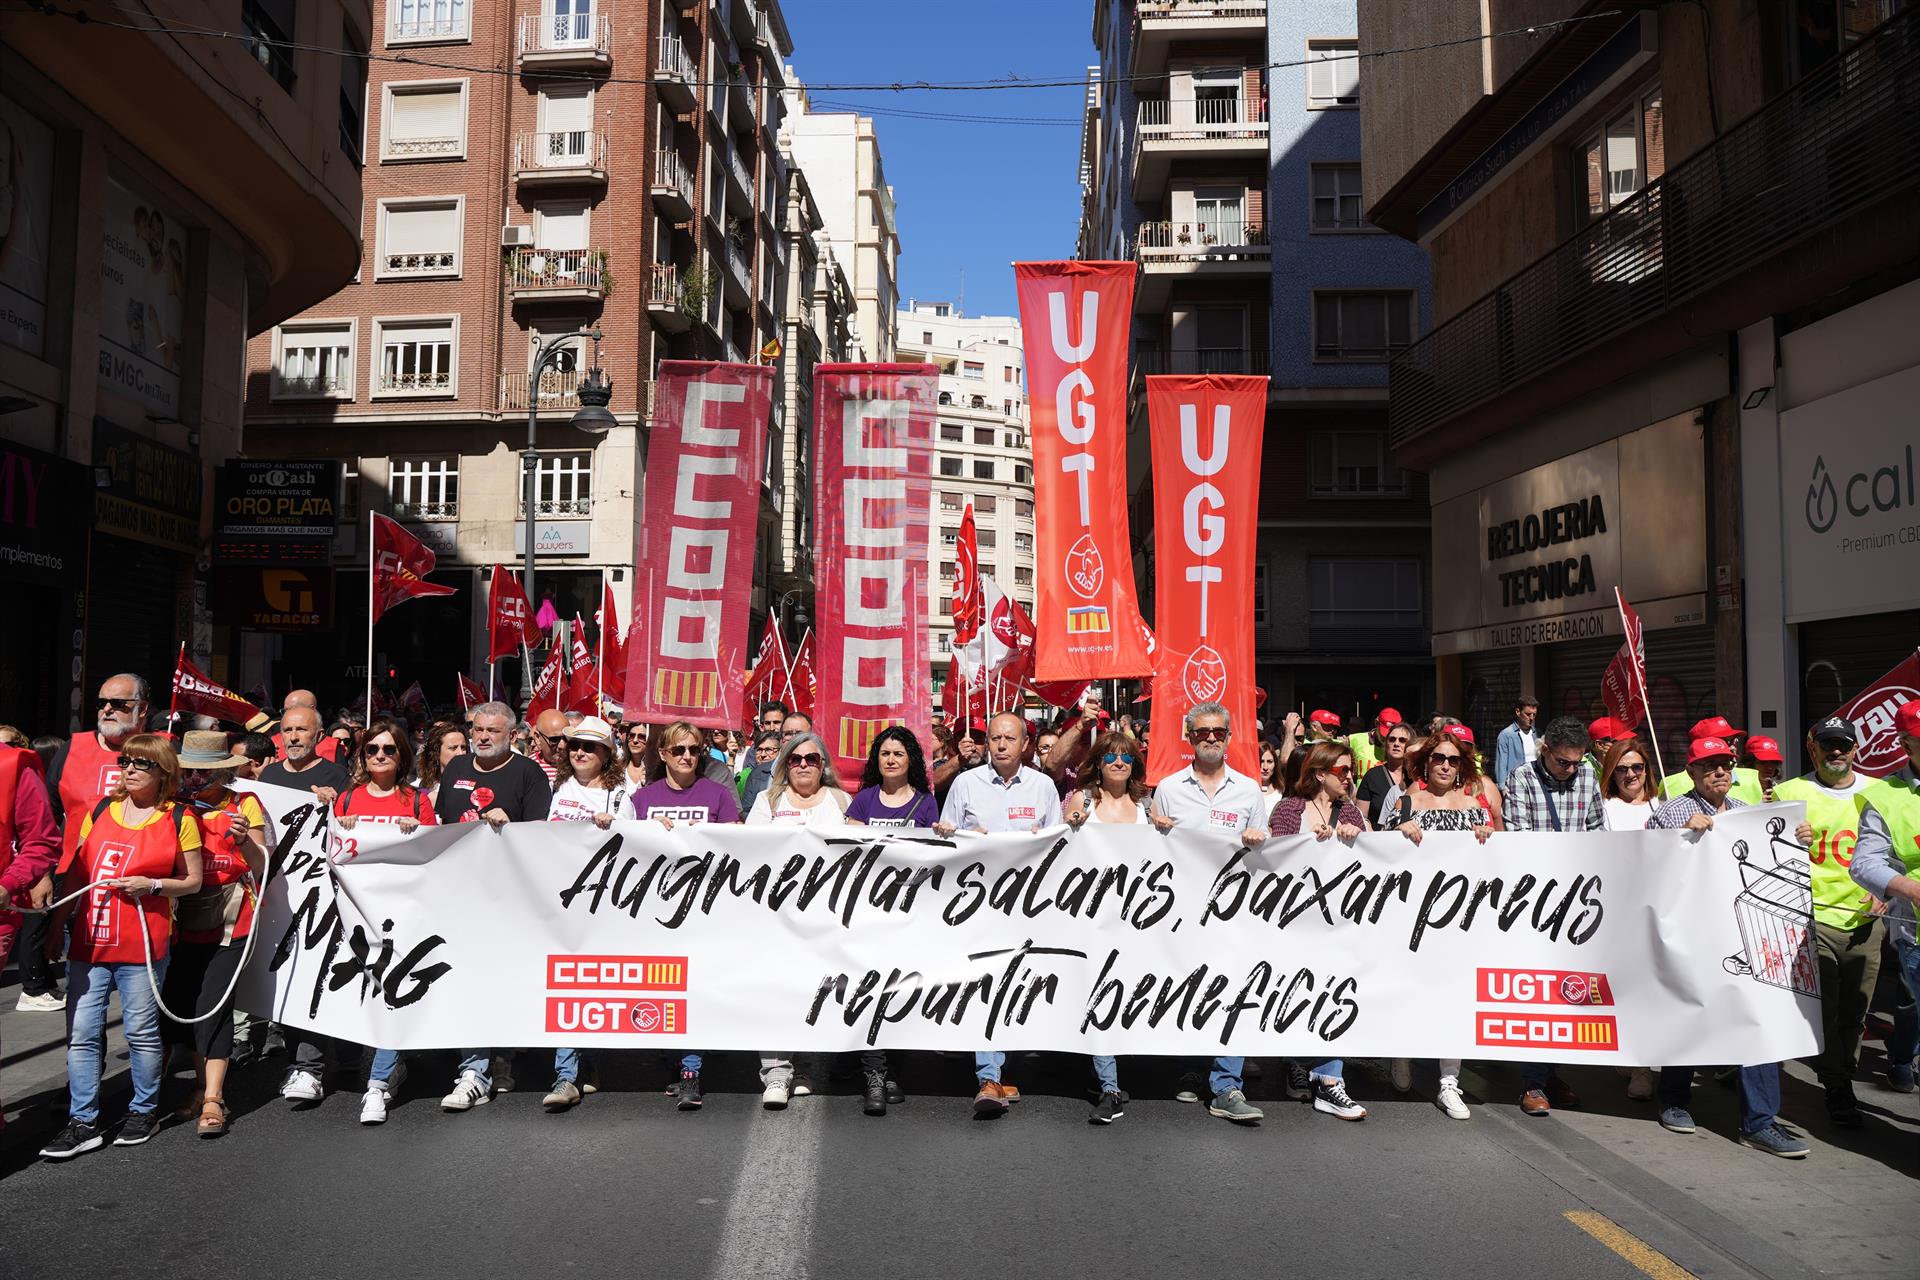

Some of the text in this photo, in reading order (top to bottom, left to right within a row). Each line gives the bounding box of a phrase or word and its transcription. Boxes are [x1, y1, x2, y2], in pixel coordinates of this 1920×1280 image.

[7, 310, 38, 336] Experts
[114, 355, 144, 393] MGC
[1048, 290, 1100, 527] UGT
[287, 463, 325, 471] INSTANTE
[227, 497, 334, 515] ORO PLATA
[660, 381, 746, 660] CCOO
[1179, 403, 1231, 638] UGT
[542, 530, 562, 541] AA
[1488, 494, 1608, 561] RELOJERIA
[1843, 532, 1895, 552] Premium
[535, 541, 574, 552] awyers
[841, 399, 911, 705] CCOO
[1499, 553, 1596, 608] TECNICA
[253, 613, 321, 625] TABACOS
[1491, 612, 1605, 648] TALLER DE REPARACIÓN
[651, 810, 704, 820] CCOO
[1009, 808, 1025, 816] UGT
[1211, 809, 1228, 821] UGT
[1222, 821, 1236, 829] FICA
[1808, 829, 1858, 868] UG
[283, 850, 328, 884] DE
[91, 849, 124, 926] CCOO
[560, 833, 1602, 953] Augmentar salaris, baixar preus
[554, 961, 643, 984] CCOO
[1487, 972, 1556, 1001] UGT
[805, 938, 1360, 1047] repartir beneficis
[557, 1001, 627, 1031] UGT
[1482, 1018, 1574, 1044] CCOO
